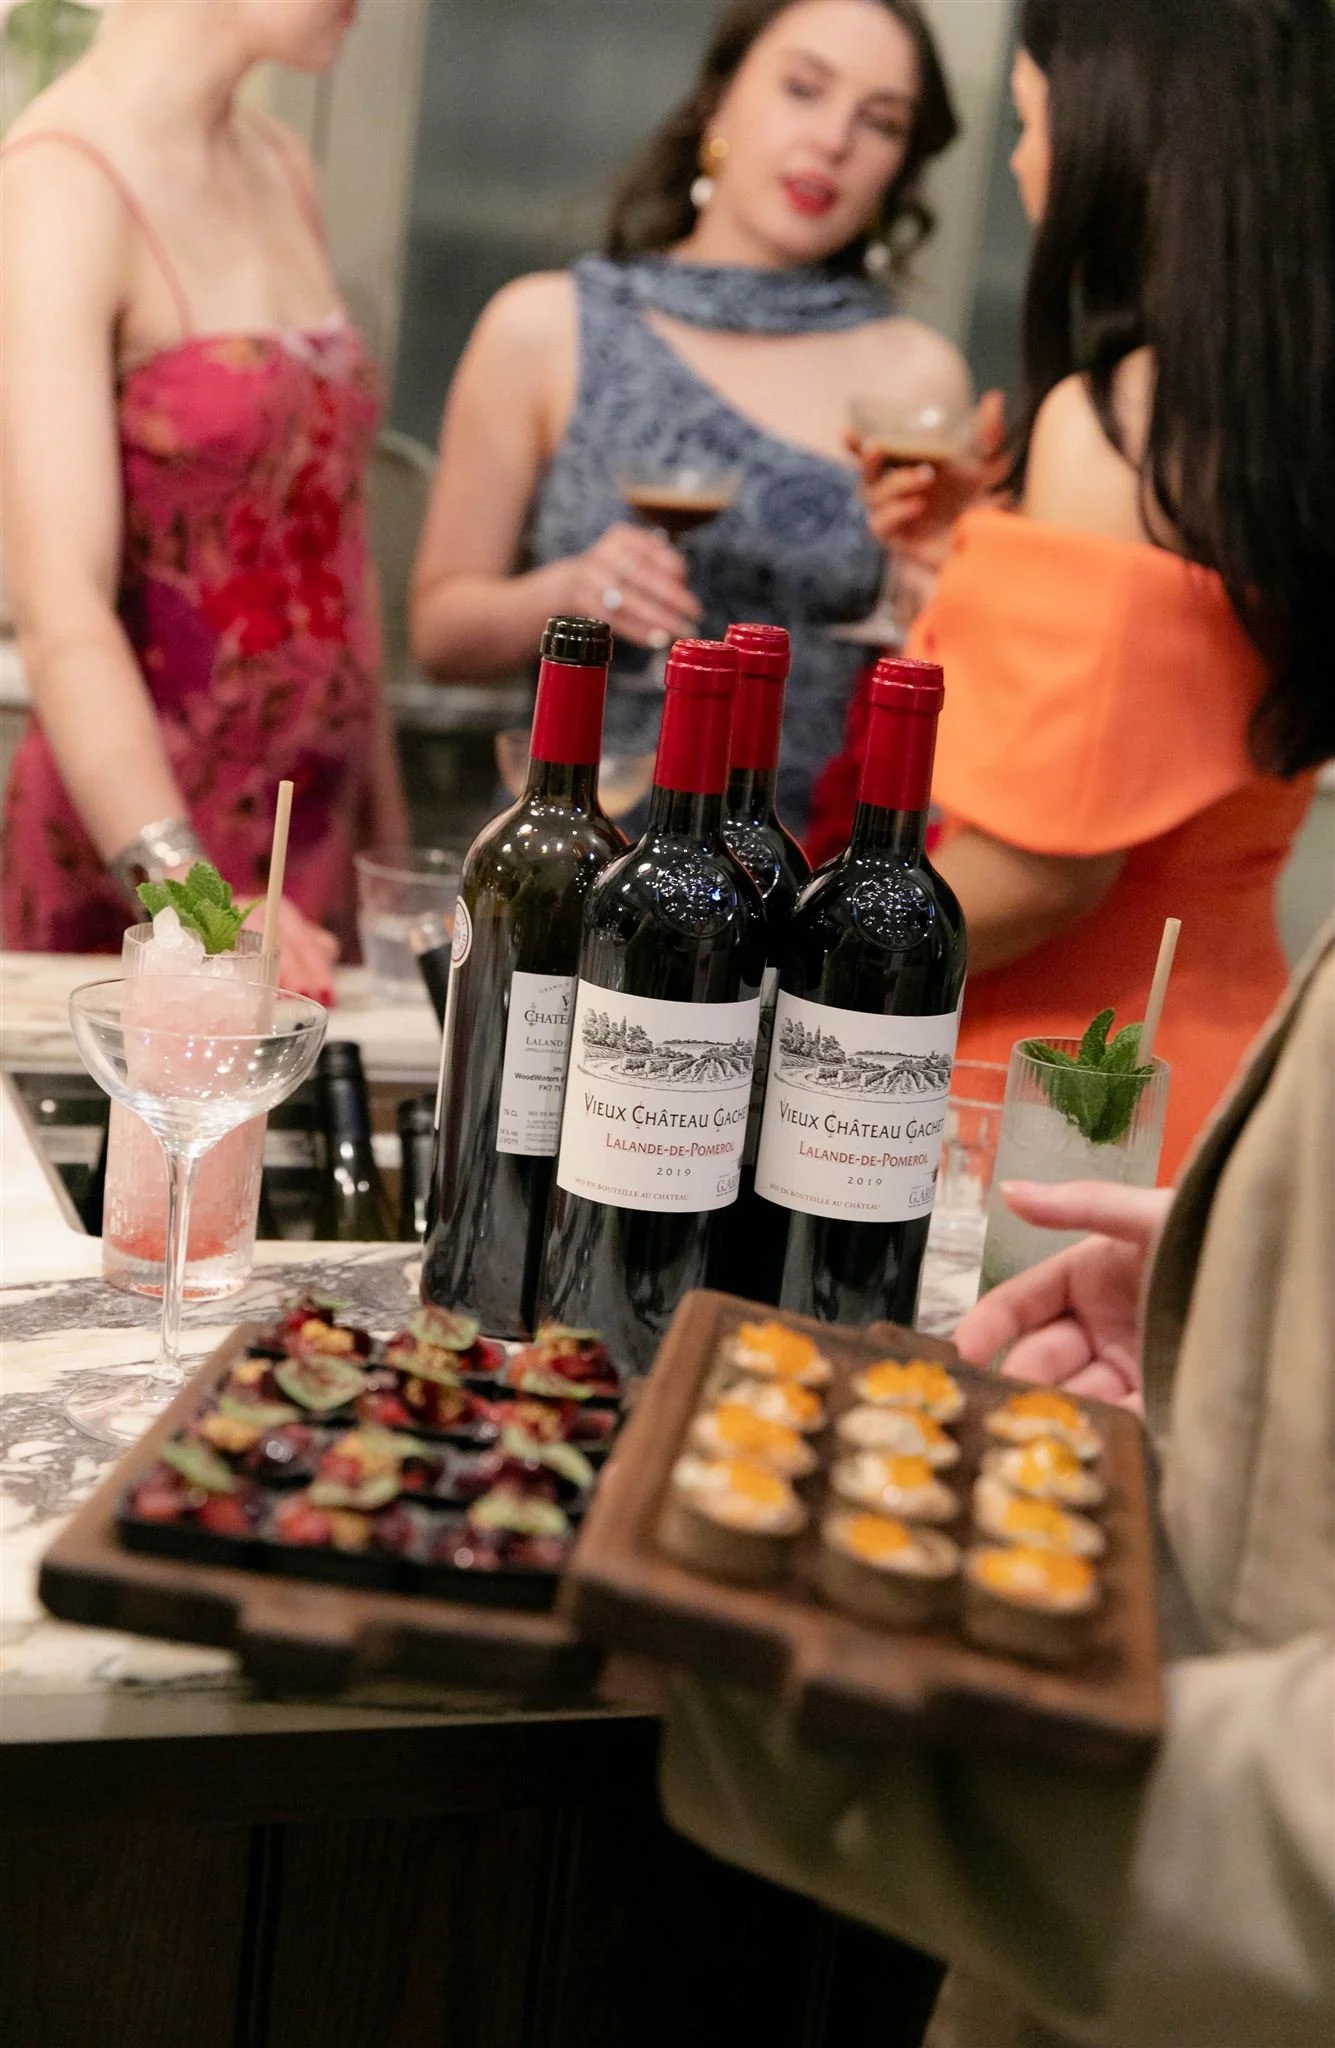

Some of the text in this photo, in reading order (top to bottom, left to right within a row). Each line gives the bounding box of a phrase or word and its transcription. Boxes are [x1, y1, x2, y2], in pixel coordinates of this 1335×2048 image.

[524, 1009, 570, 1026] CHATE
[584, 1092, 626, 1122] VIEUX
[632, 1105, 709, 1128] CHÂTEAU
[780, 1100, 819, 1130] VIEUX
[824, 1114, 901, 1139] CHÂTEAU
[606, 1133, 734, 1156] LALANDE-DE-POMEROL
[799, 1141, 928, 1167] LALANDE-DE-POMEROL
[656, 1167, 691, 1177] 2019
[847, 1176, 883, 1186] 2019
[597, 1183, 637, 1198] BOUTEILLE
